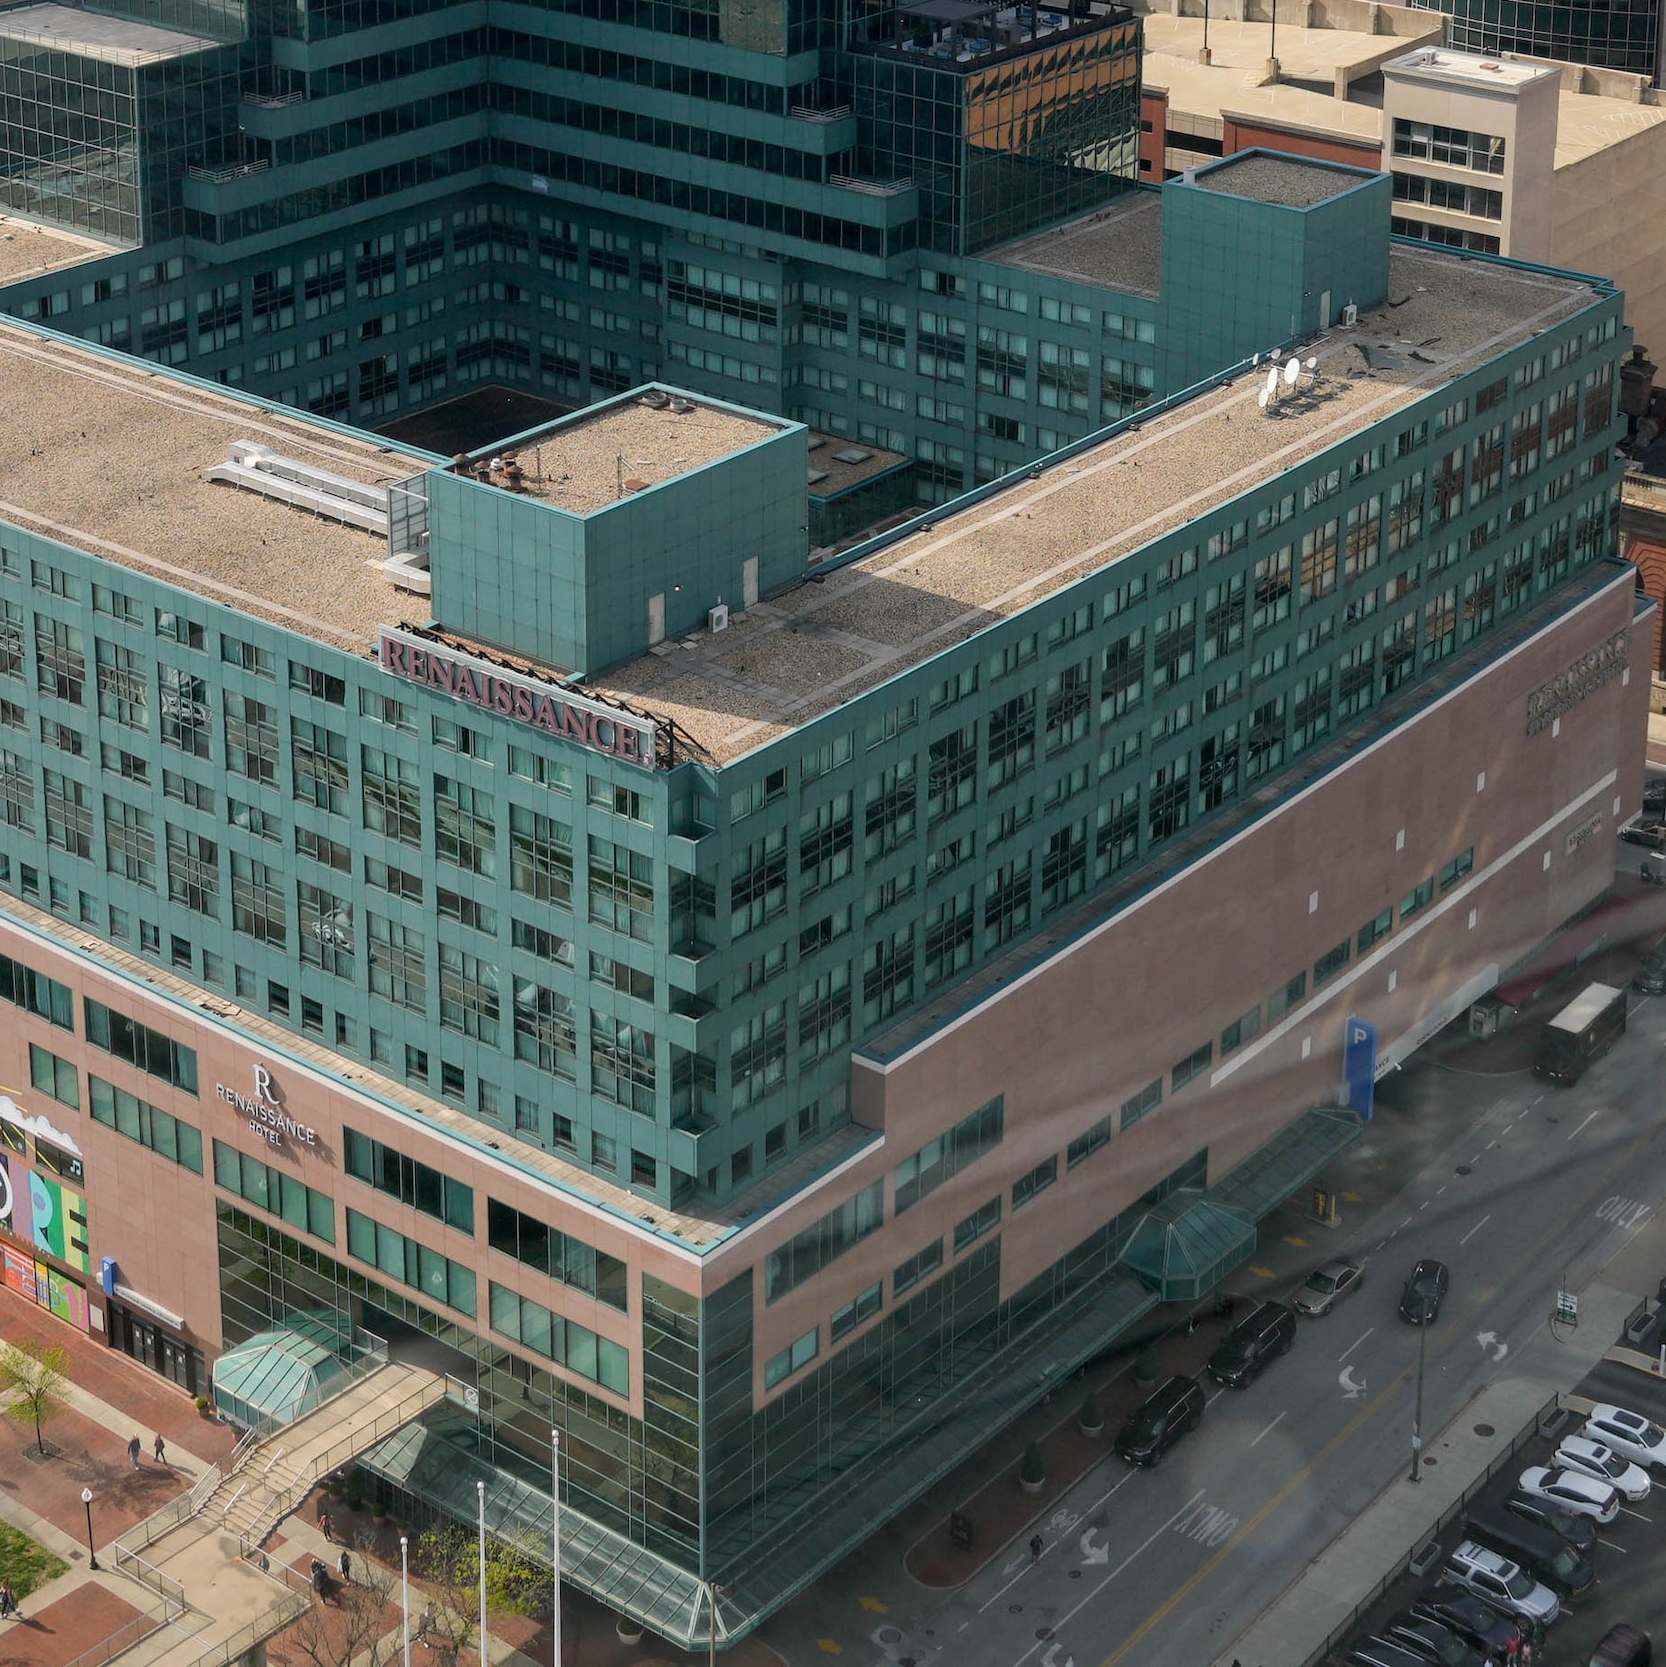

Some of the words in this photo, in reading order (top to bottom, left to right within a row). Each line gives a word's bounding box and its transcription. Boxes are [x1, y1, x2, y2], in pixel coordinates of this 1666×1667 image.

[381, 635, 639, 763] RENAISSANCE
[1354, 1027, 1367, 1044] P
[253, 1063, 280, 1105] R
[216, 1083, 316, 1146] RENAISSANCE
[249, 1120, 282, 1146] HOTEL
[1595, 1194, 1651, 1229] ONLY
[1173, 1502, 1239, 1547] ONLY
